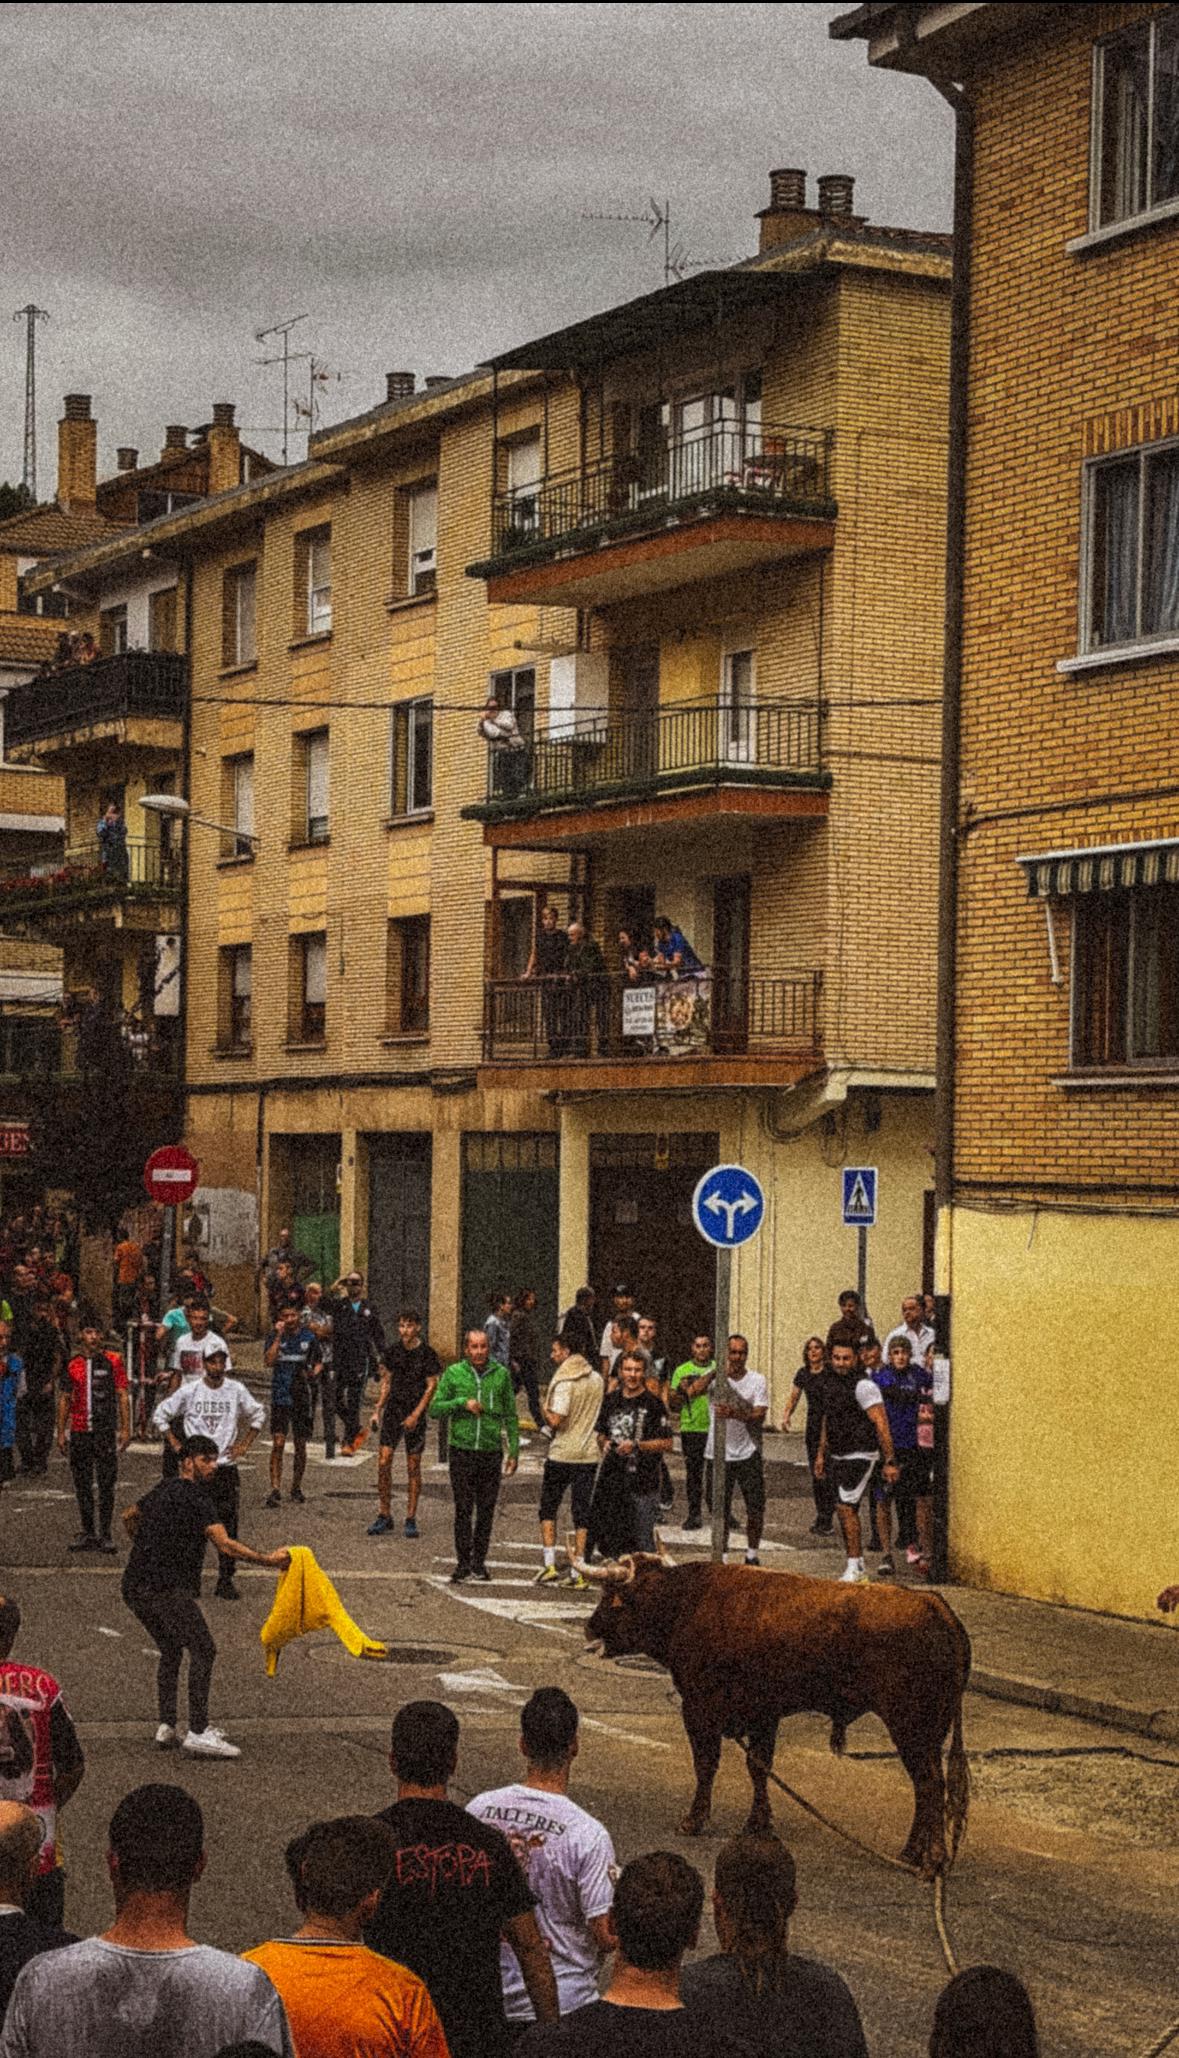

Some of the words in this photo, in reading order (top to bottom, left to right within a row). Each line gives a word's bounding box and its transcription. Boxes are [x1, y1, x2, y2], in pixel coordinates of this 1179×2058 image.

[195, 1401, 231, 1413] GUESS
[485, 1805, 567, 1836] TALLERES
[395, 1842, 492, 1896] ESTOPA
